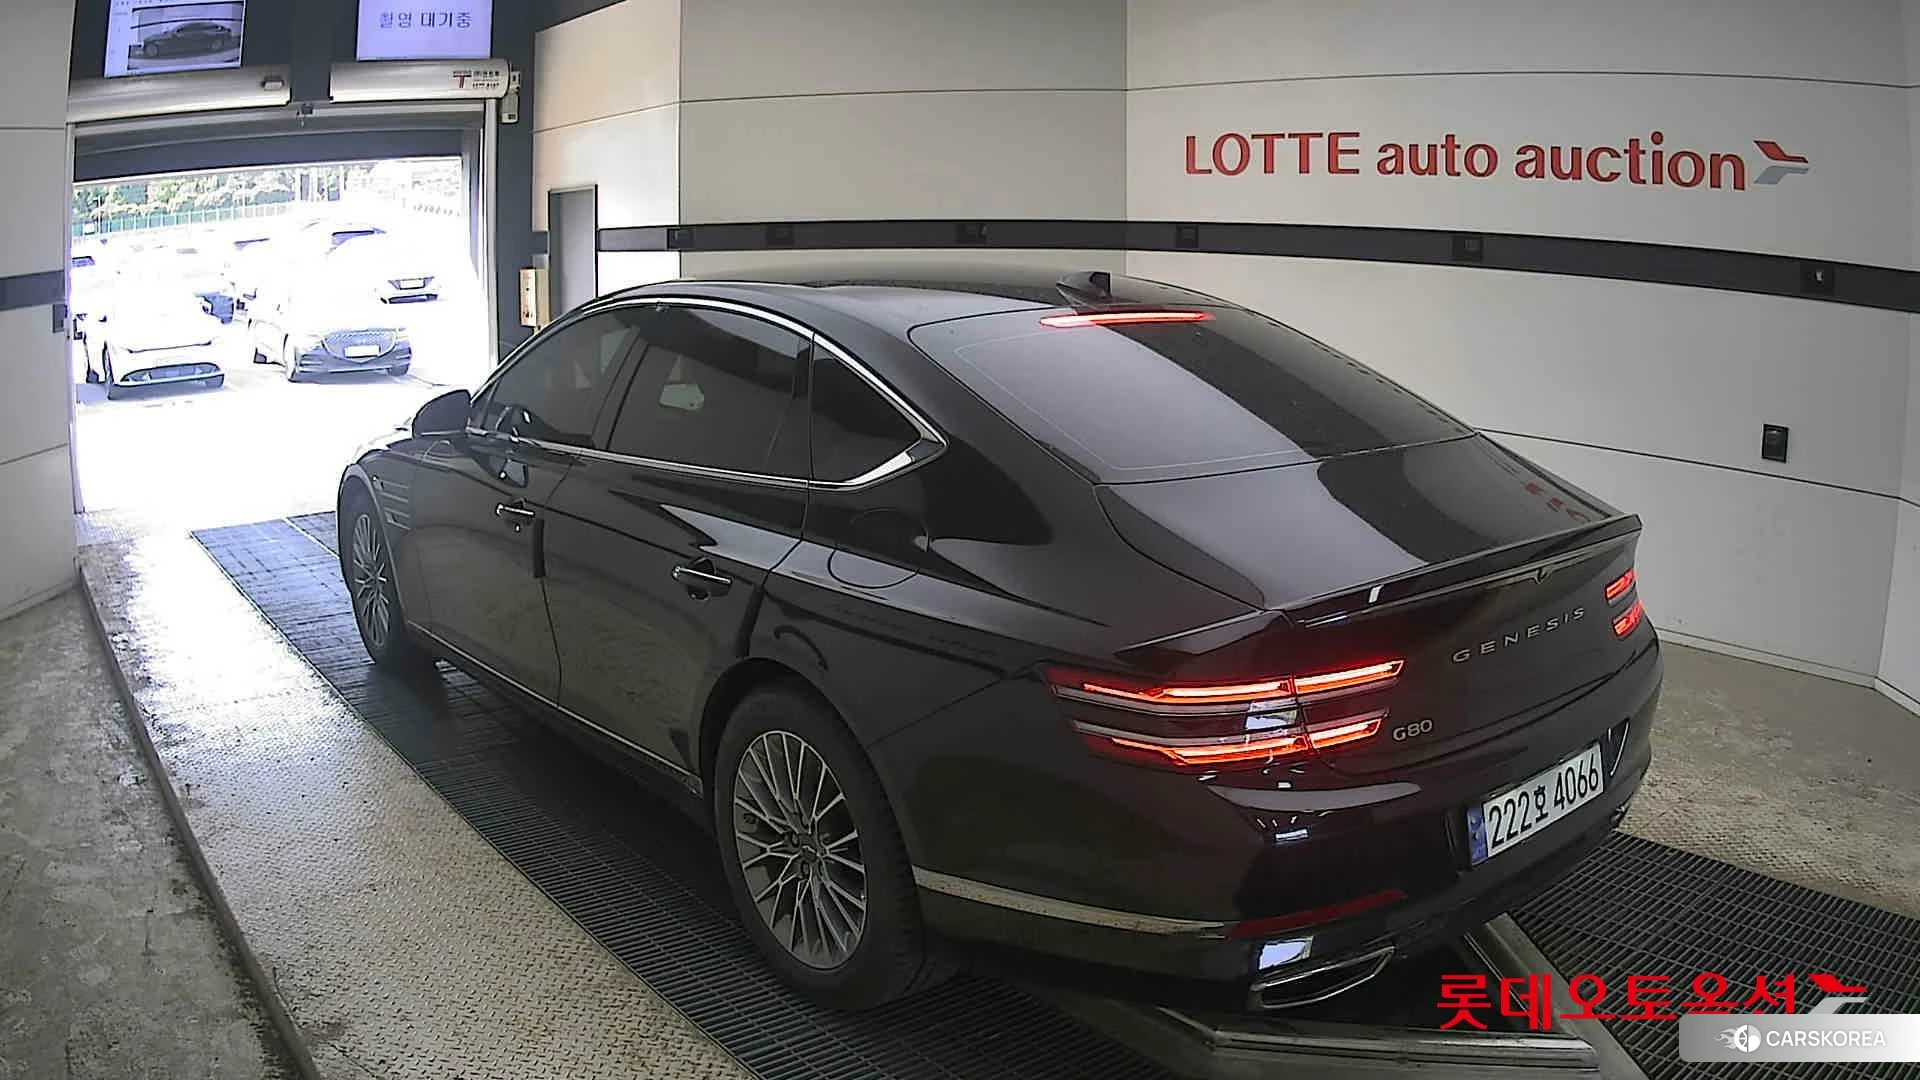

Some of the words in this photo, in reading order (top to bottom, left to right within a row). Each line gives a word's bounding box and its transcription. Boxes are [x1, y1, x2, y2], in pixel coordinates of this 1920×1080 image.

[421, 12, 473, 29] 대기중
[1185, 132, 1360, 176] LOTTE
[1376, 133, 1498, 178] auto
[1515, 131, 1745, 190] auction
[1453, 607, 1585, 663] GENESIS
[1392, 719, 1433, 742] G80
[1489, 785, 1549, 849] 222호
[1553, 753, 1599, 810] 4066
